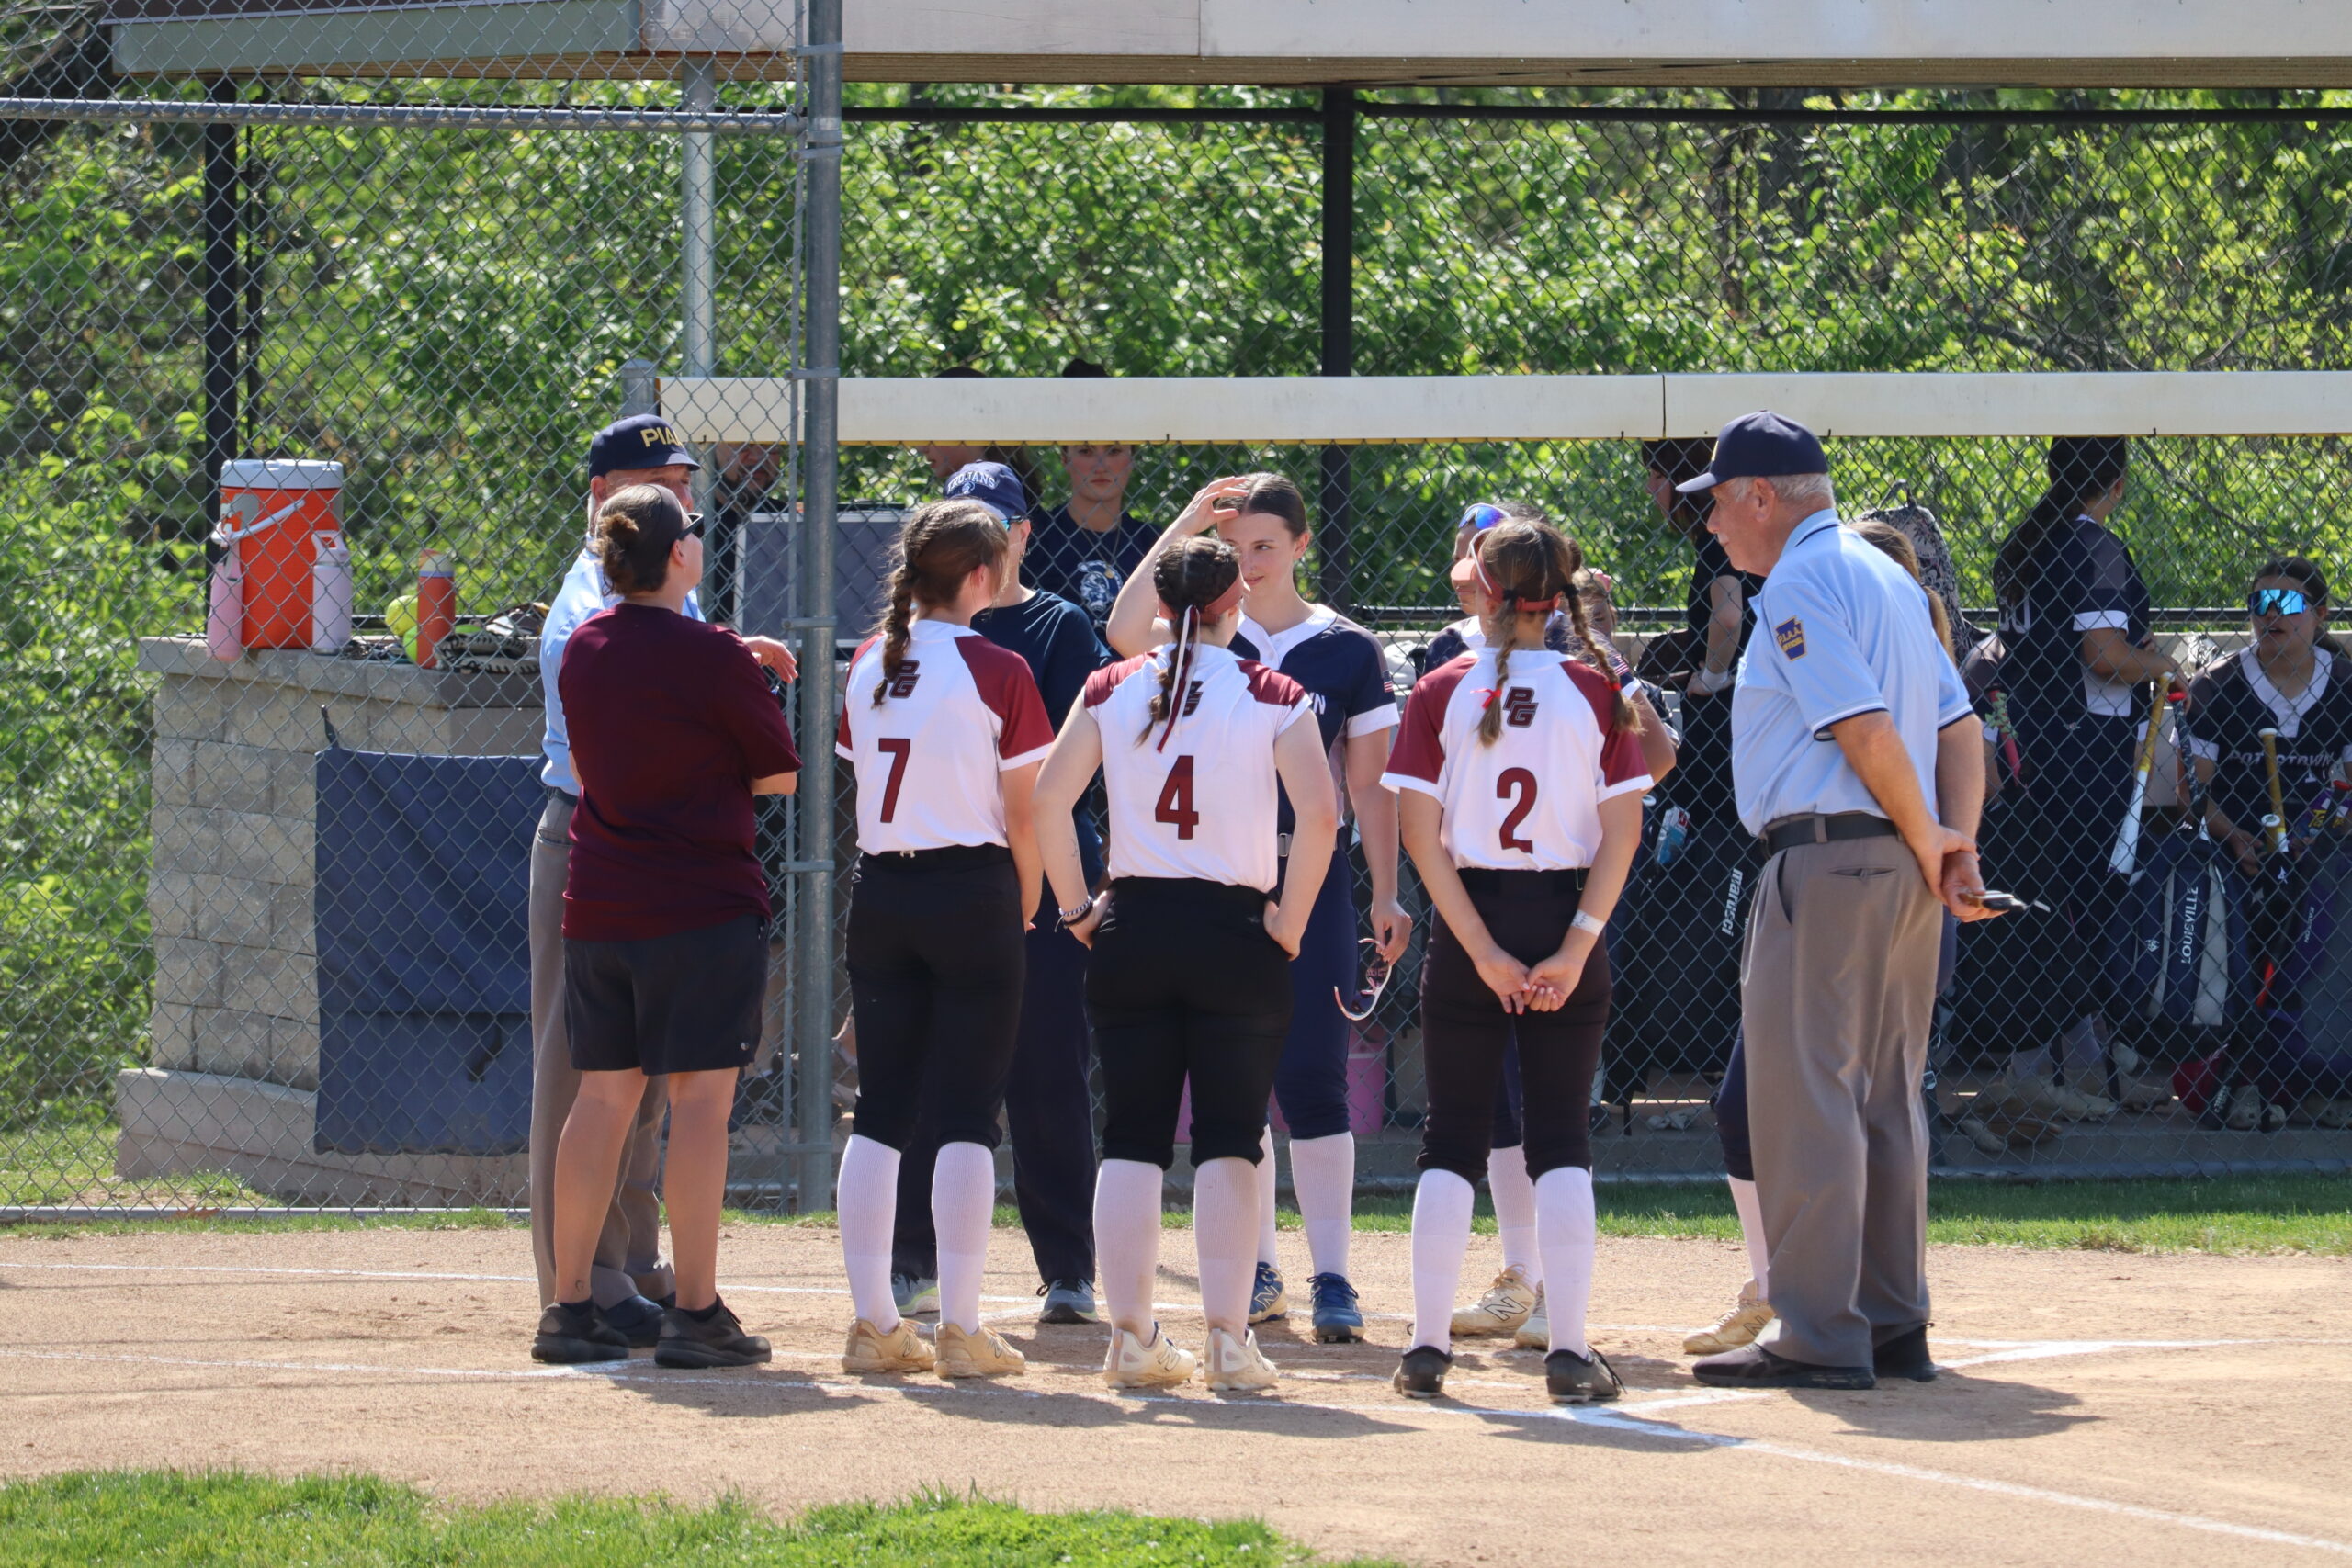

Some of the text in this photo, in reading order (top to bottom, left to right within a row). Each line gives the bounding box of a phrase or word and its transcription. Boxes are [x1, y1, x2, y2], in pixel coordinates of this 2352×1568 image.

[947, 470, 997, 494] TROJANS
[1503, 686, 1539, 728] PG
[878, 738, 910, 823] 7
[1155, 755, 1199, 840] 4
[1497, 767, 1537, 854] 2
[2181, 886, 2199, 964] LOUISVILLE
